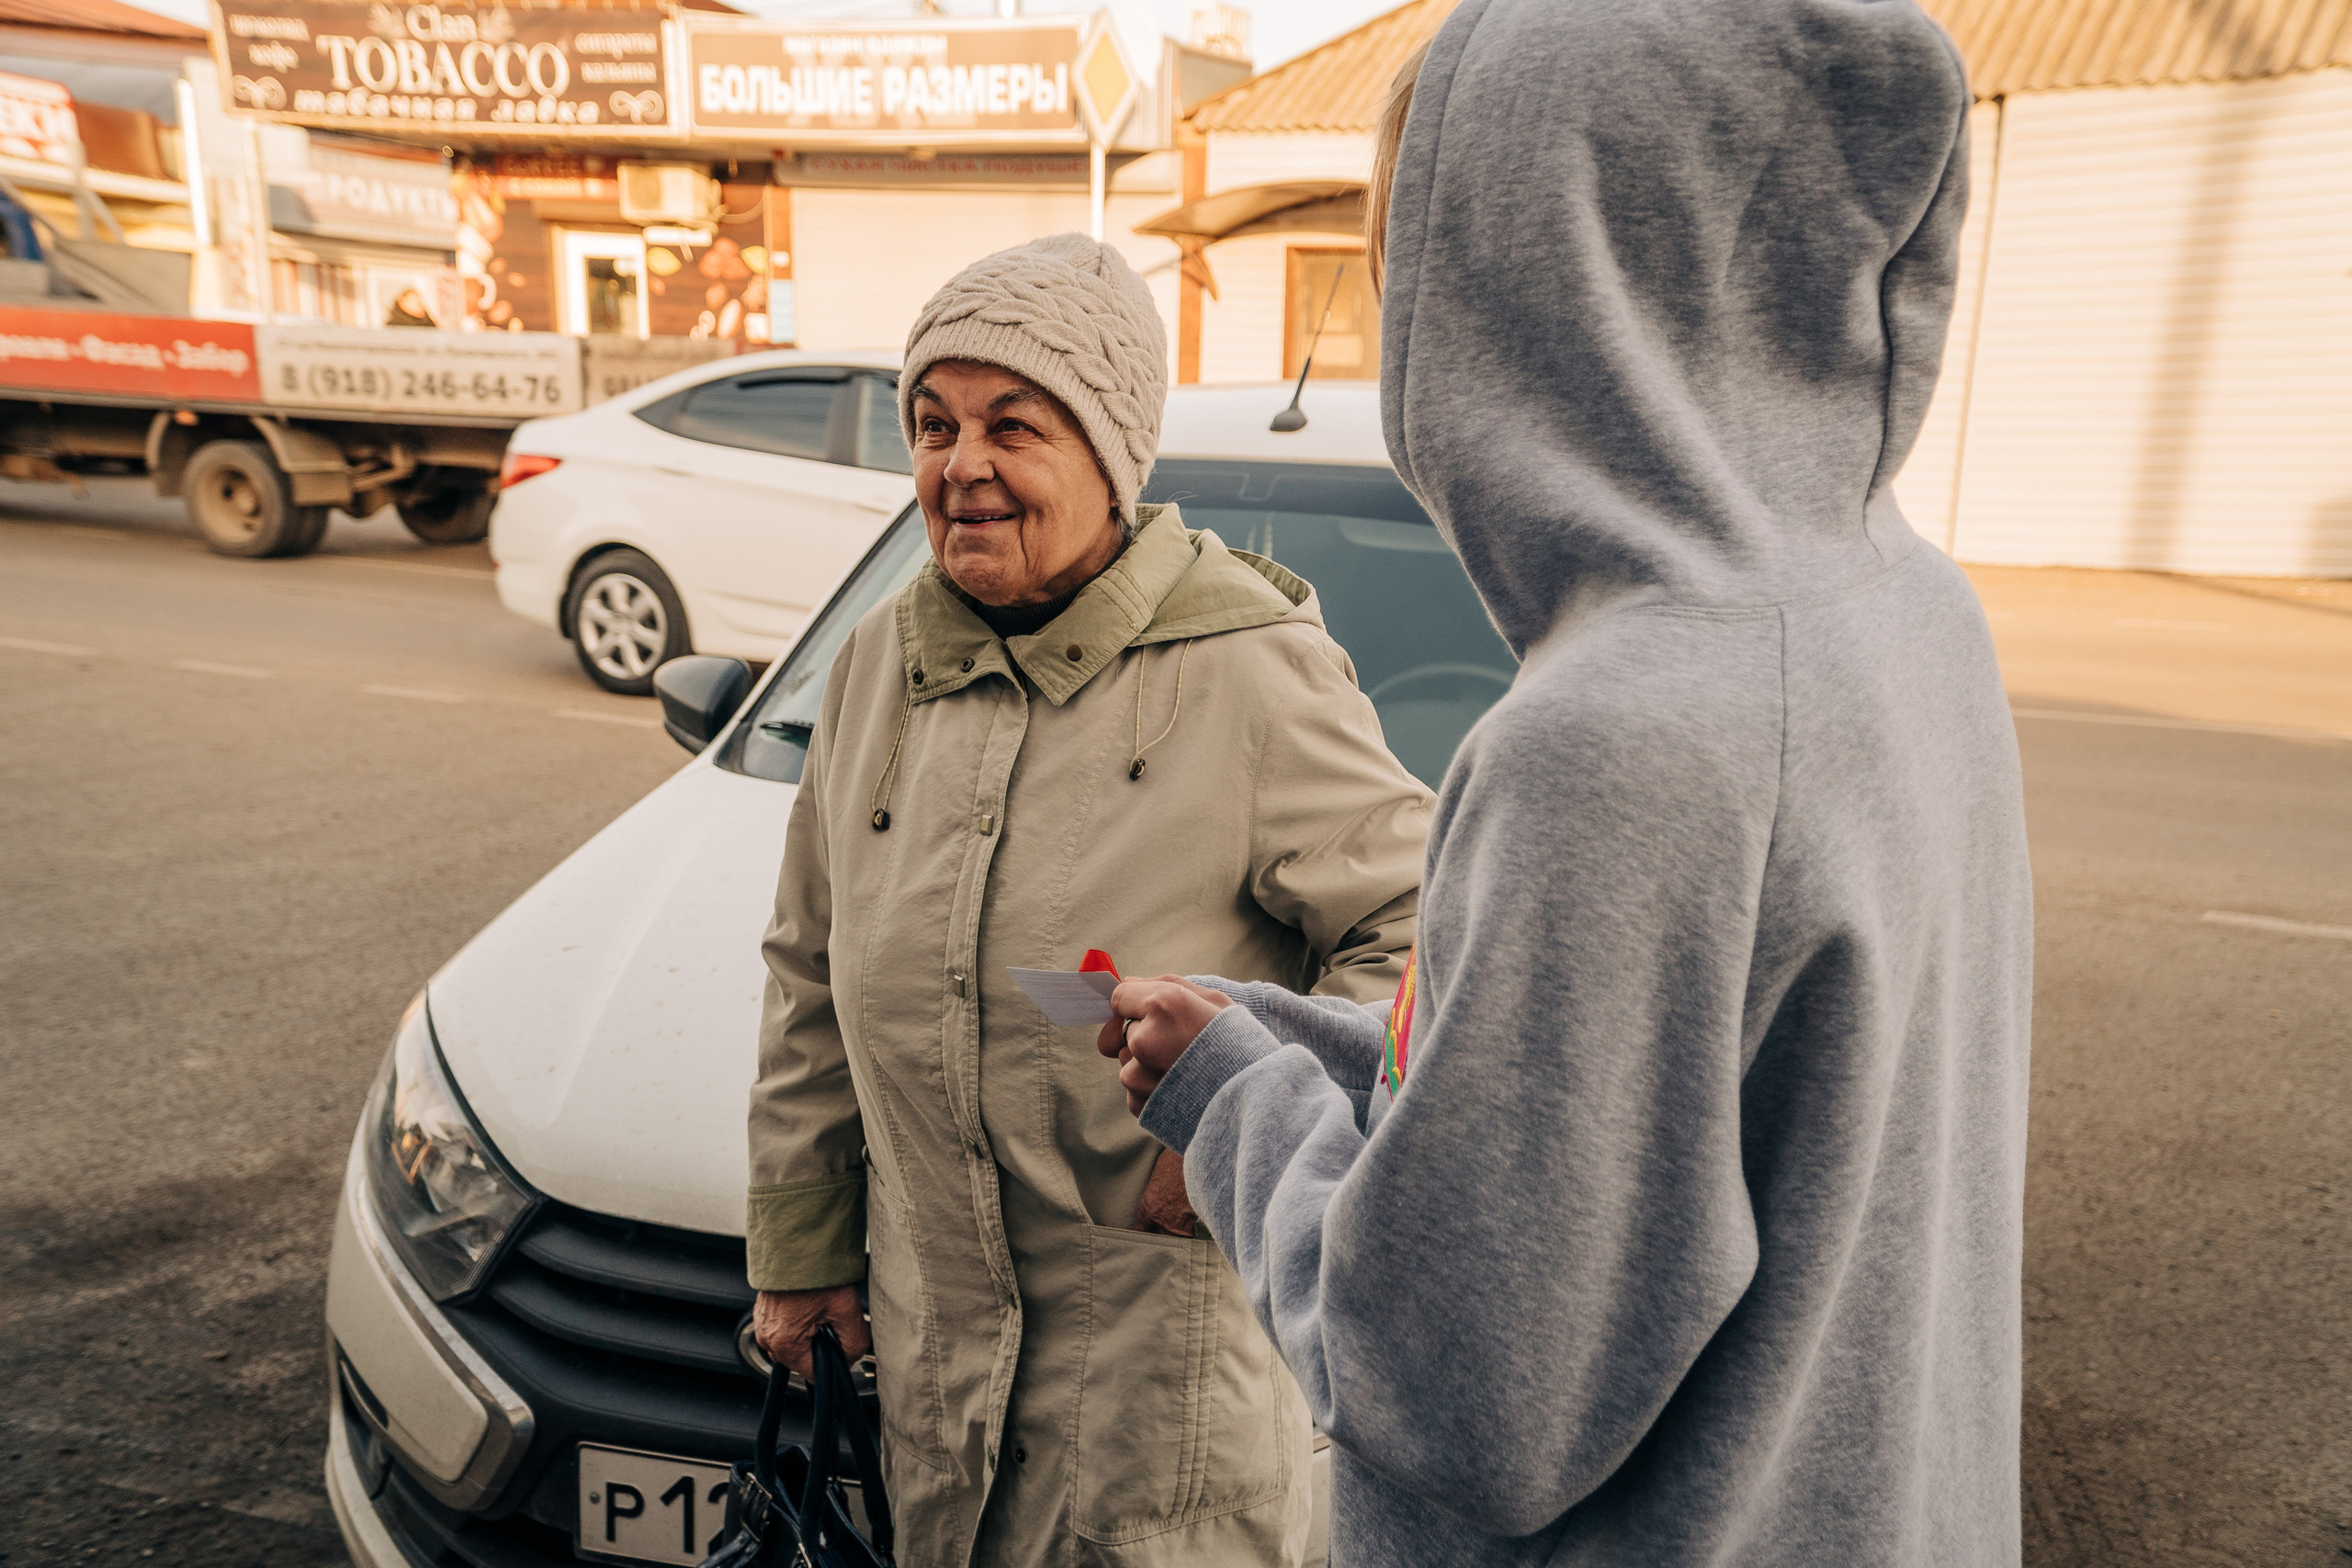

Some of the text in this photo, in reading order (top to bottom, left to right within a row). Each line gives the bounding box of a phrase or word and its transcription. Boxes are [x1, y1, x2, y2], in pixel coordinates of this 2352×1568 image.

[405, 5, 478, 43] Clan
[315, 35, 571, 98] TOBACCO
[294, 86, 600, 125] табачная лавка
[698, 62, 1069, 116] БОЛЬШИЕ РАЗМЕРЫ
[282, 364, 562, 404] 8 (918) 246-64-76
